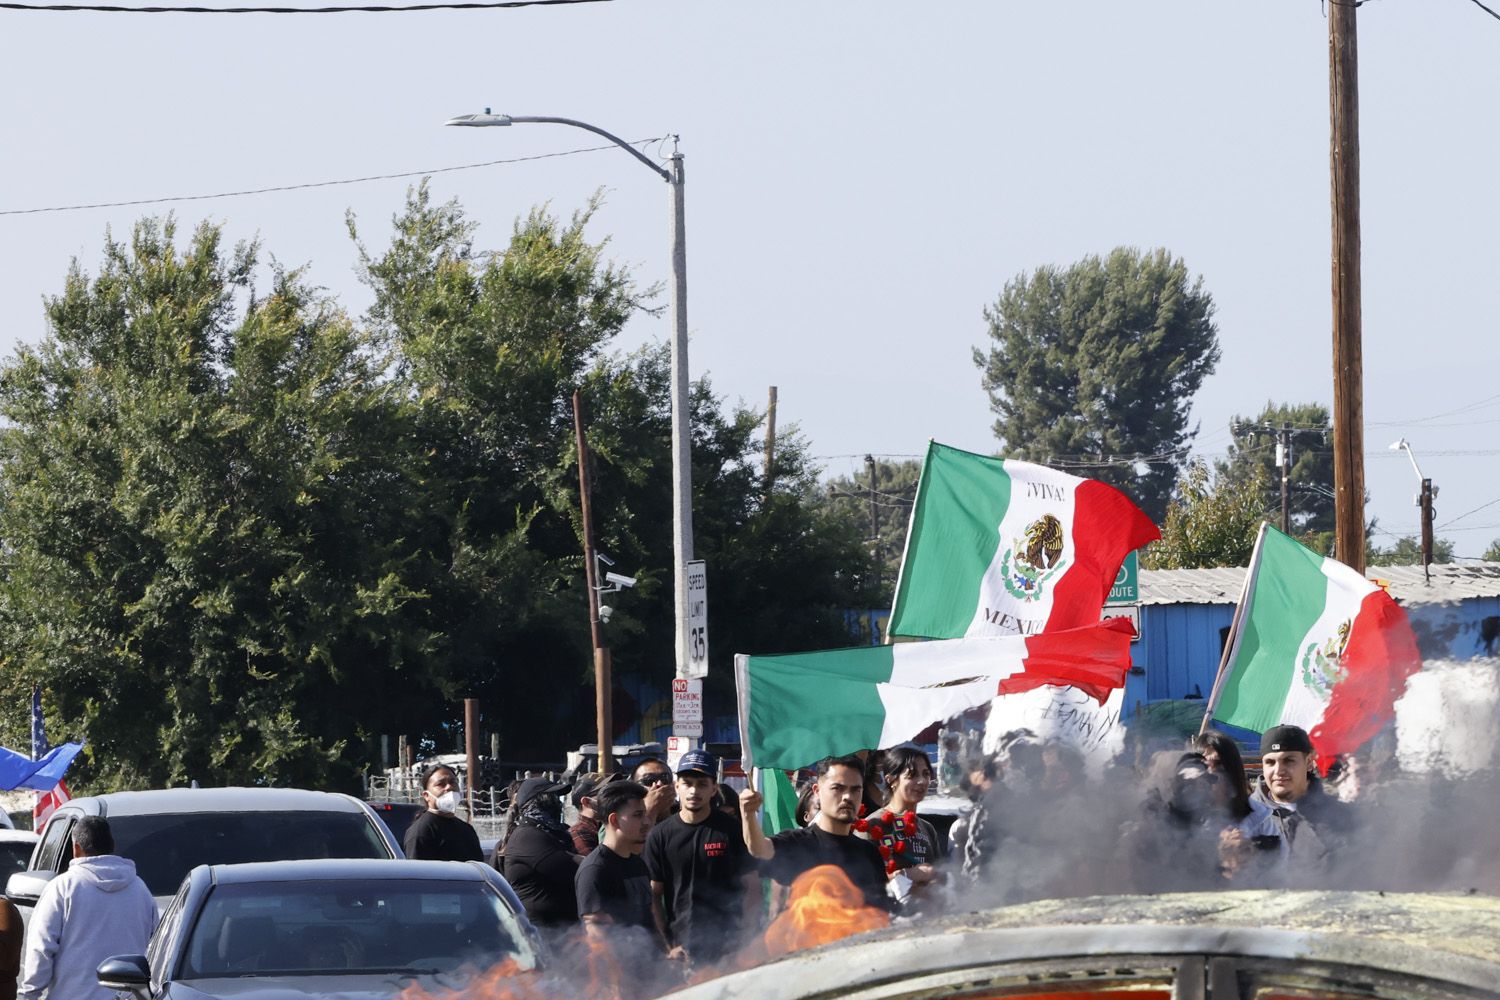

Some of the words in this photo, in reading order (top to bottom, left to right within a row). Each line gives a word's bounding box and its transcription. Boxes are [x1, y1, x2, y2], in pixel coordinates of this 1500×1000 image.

[688, 574, 705, 591] SPEED
[1107, 586, 1134, 598] OUTE
[690, 600, 704, 618] LIMIT
[691, 626, 706, 663] 35
[674, 681, 687, 691] NO
[675, 693, 700, 701] PARKING
